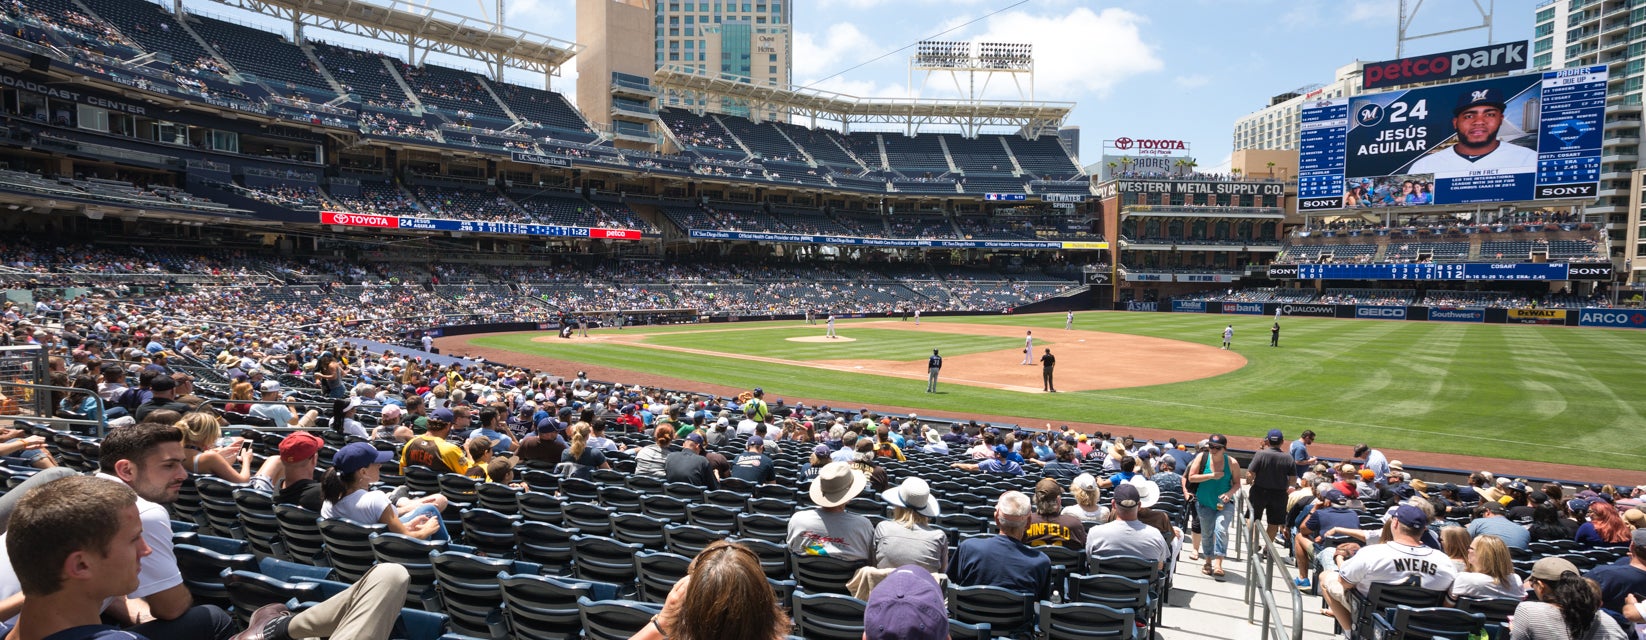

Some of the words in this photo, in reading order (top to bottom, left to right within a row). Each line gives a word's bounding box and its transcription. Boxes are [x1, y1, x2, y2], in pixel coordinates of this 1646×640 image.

[1556, 68, 1591, 78] PADRES
[112, 76, 135, 86] RANDY
[86, 96, 146, 115] CENTER
[1390, 99, 1428, 122] 24
[1376, 124, 1427, 142] JESÚS
[1136, 139, 1184, 150] TOYOTA
[1357, 140, 1427, 156] AGUILAR
[1133, 158, 1170, 172] PADRES
[1118, 182, 1171, 192] WESTERN
[1177, 183, 1213, 193] METAL
[1217, 184, 1260, 194] SUPPLY
[1265, 185, 1283, 195] CO.
[1542, 186, 1591, 196] SONY
[350, 215, 388, 226] TOYOTA
[572, 228, 587, 236] 1:22
[606, 230, 625, 238] petco
[1127, 303, 1157, 312] ASML
[1224, 304, 1235, 312] us
[1236, 304, 1261, 312] bank
[1284, 305, 1334, 314] QUALCOMM
[1358, 308, 1405, 317] GEICO
[1432, 310, 1475, 319] Southwest
[1582, 313, 1628, 324] ARCO
[1393, 558, 1438, 576] MYERS
